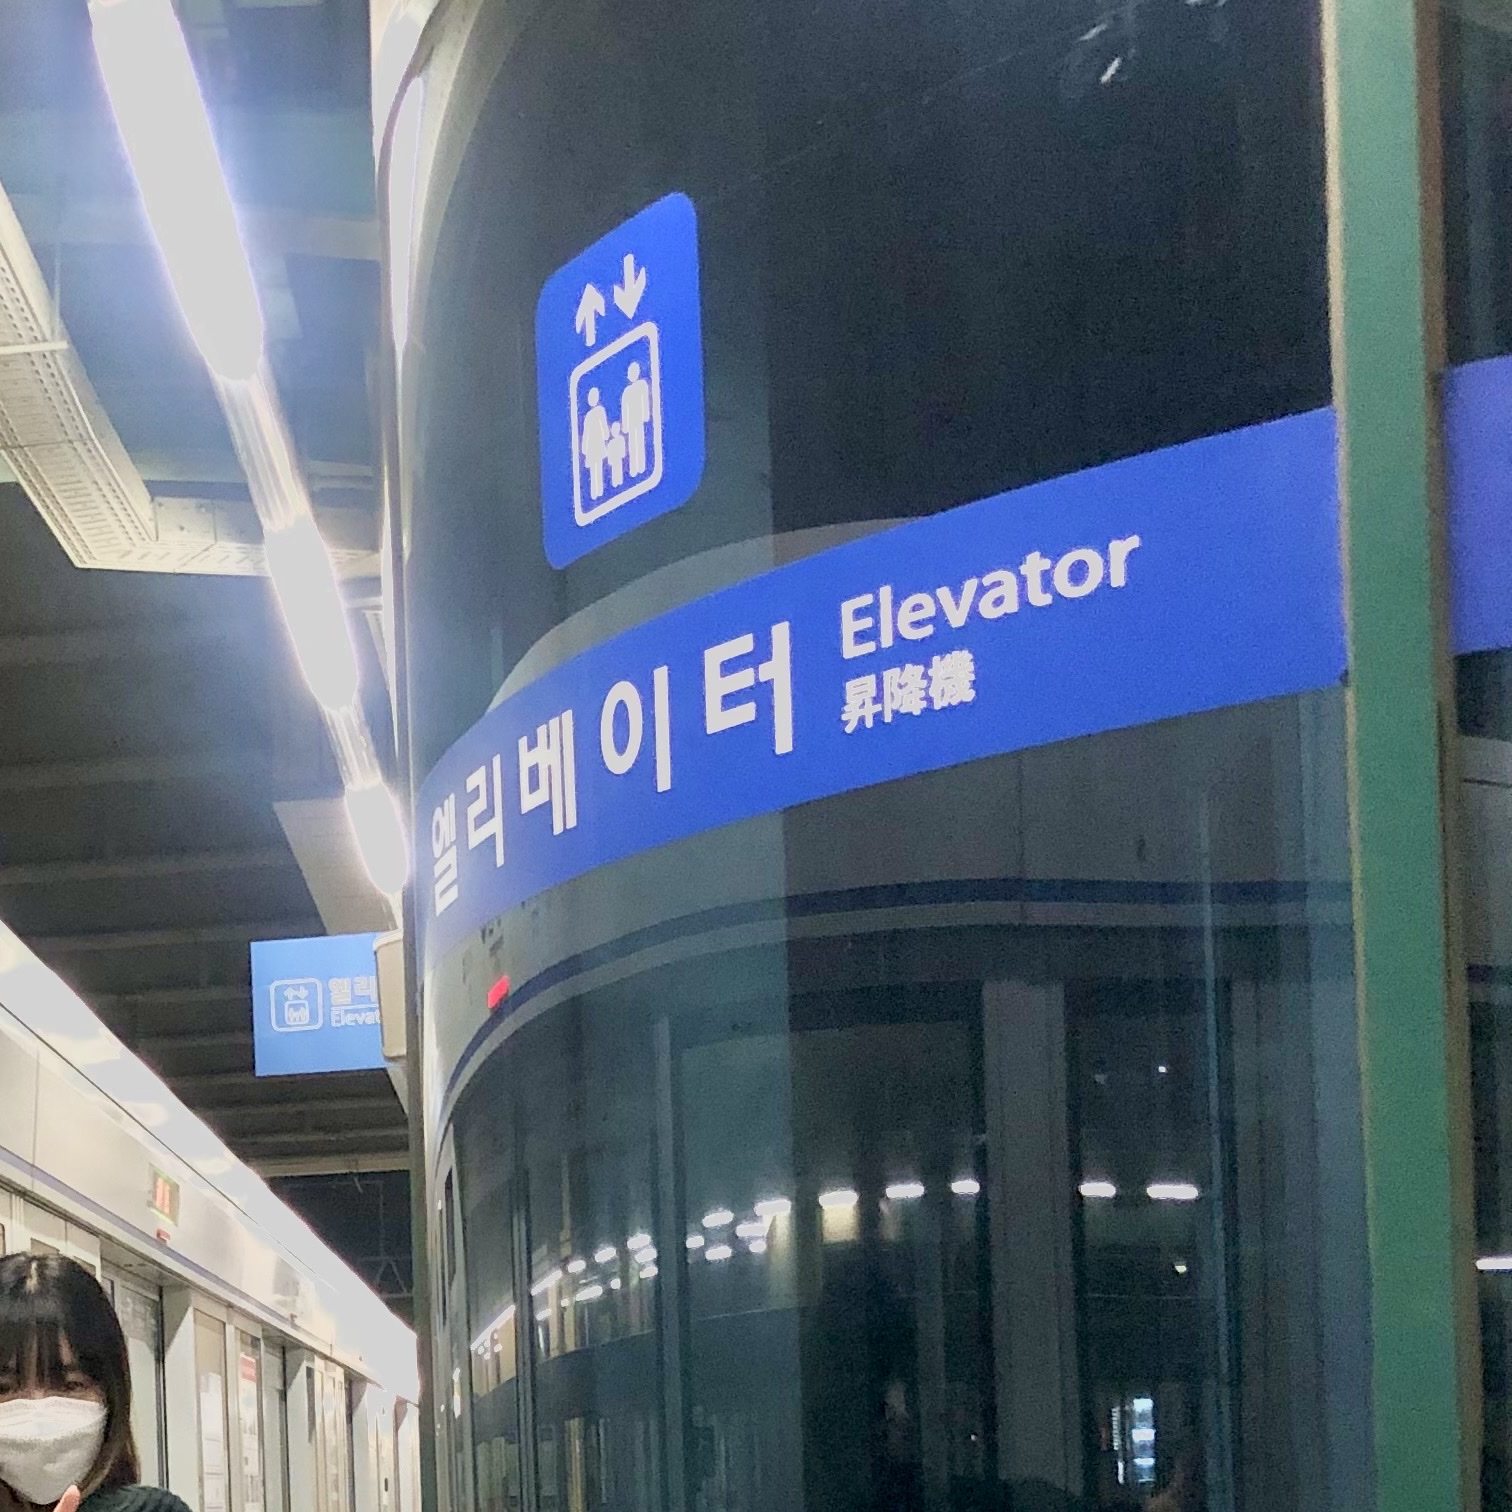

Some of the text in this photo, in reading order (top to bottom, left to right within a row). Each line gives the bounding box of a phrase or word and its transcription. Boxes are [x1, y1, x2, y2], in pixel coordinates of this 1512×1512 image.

[841, 535, 1140, 658] Elevator
[841, 652, 976, 734] 昇降機
[432, 621, 793, 917] 엘리베이터
